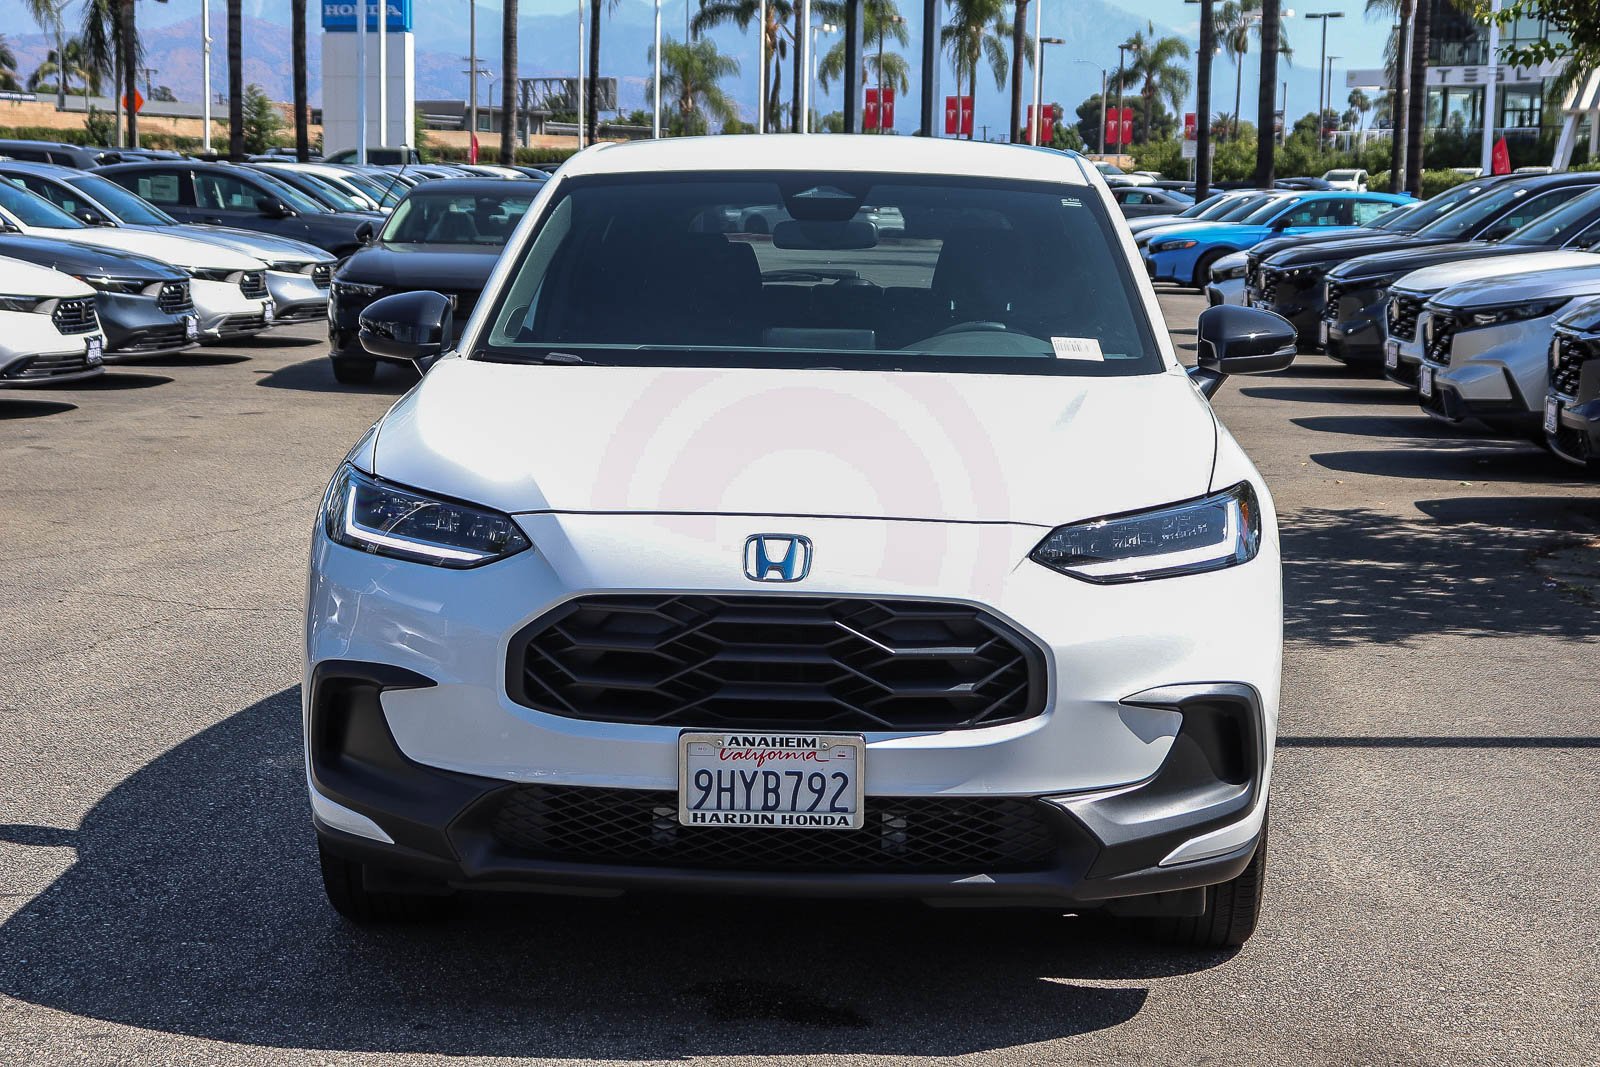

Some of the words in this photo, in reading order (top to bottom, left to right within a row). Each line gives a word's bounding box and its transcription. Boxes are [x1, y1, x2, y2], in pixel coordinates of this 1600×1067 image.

[728, 736, 817, 748] ANAHEIM
[719, 748, 830, 768] California
[693, 769, 849, 813] 9HYB792
[692, 813, 775, 825] HARDIN
[781, 815, 850, 826] HONDA
